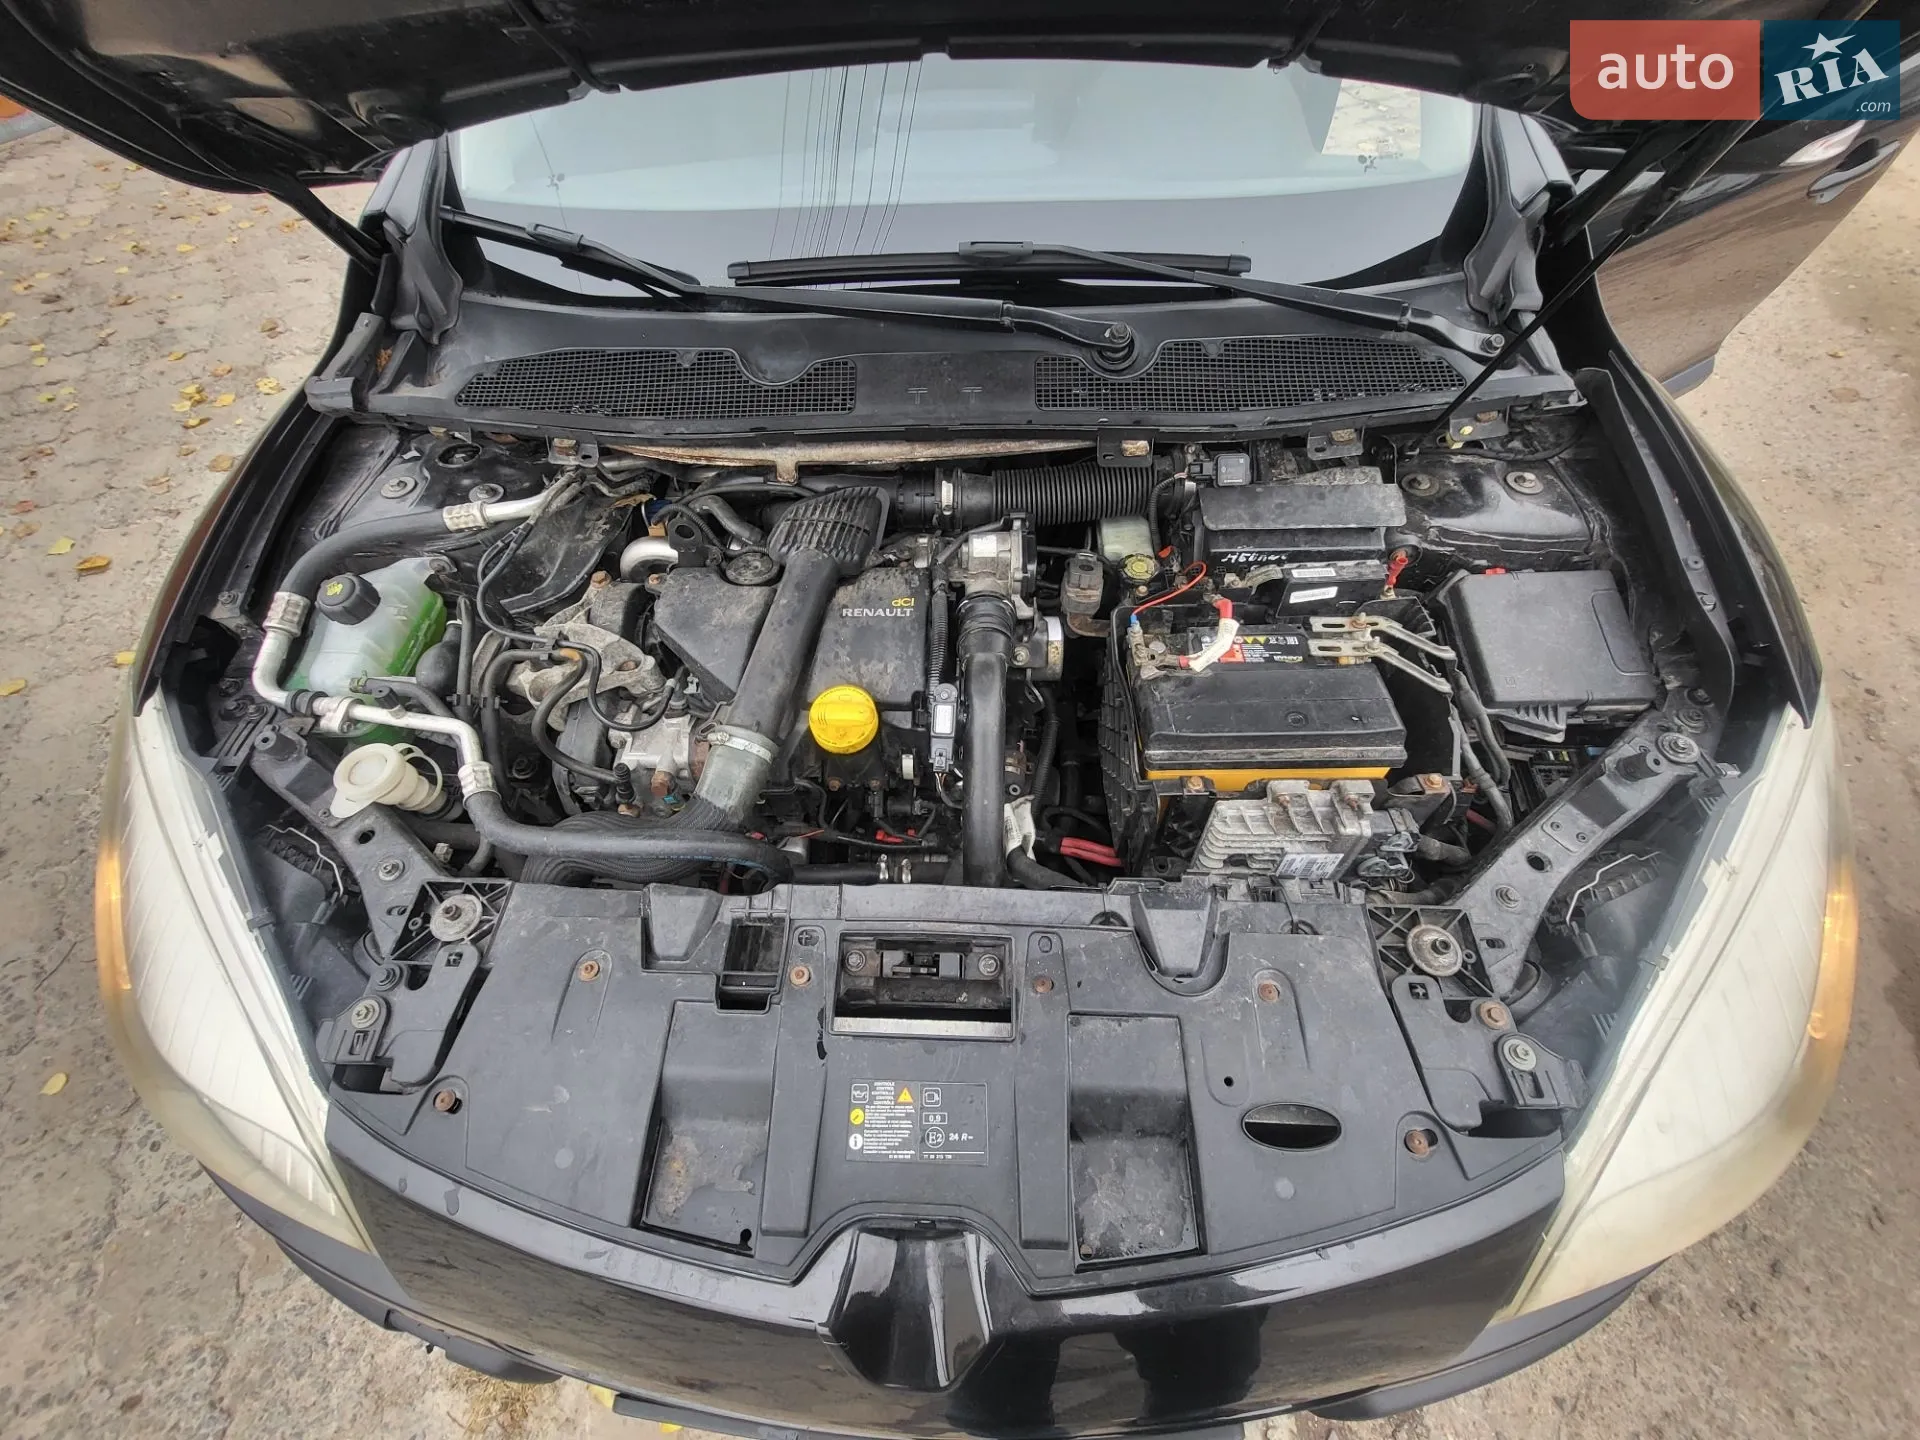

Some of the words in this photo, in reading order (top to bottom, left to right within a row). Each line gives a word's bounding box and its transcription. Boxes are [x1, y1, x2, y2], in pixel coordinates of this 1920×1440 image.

[842, 608, 914, 617] RENAULT
[928, 1115, 941, 1124] 0,9
[928, 1131, 943, 1145] E2
[948, 1133, 959, 1141] 24
